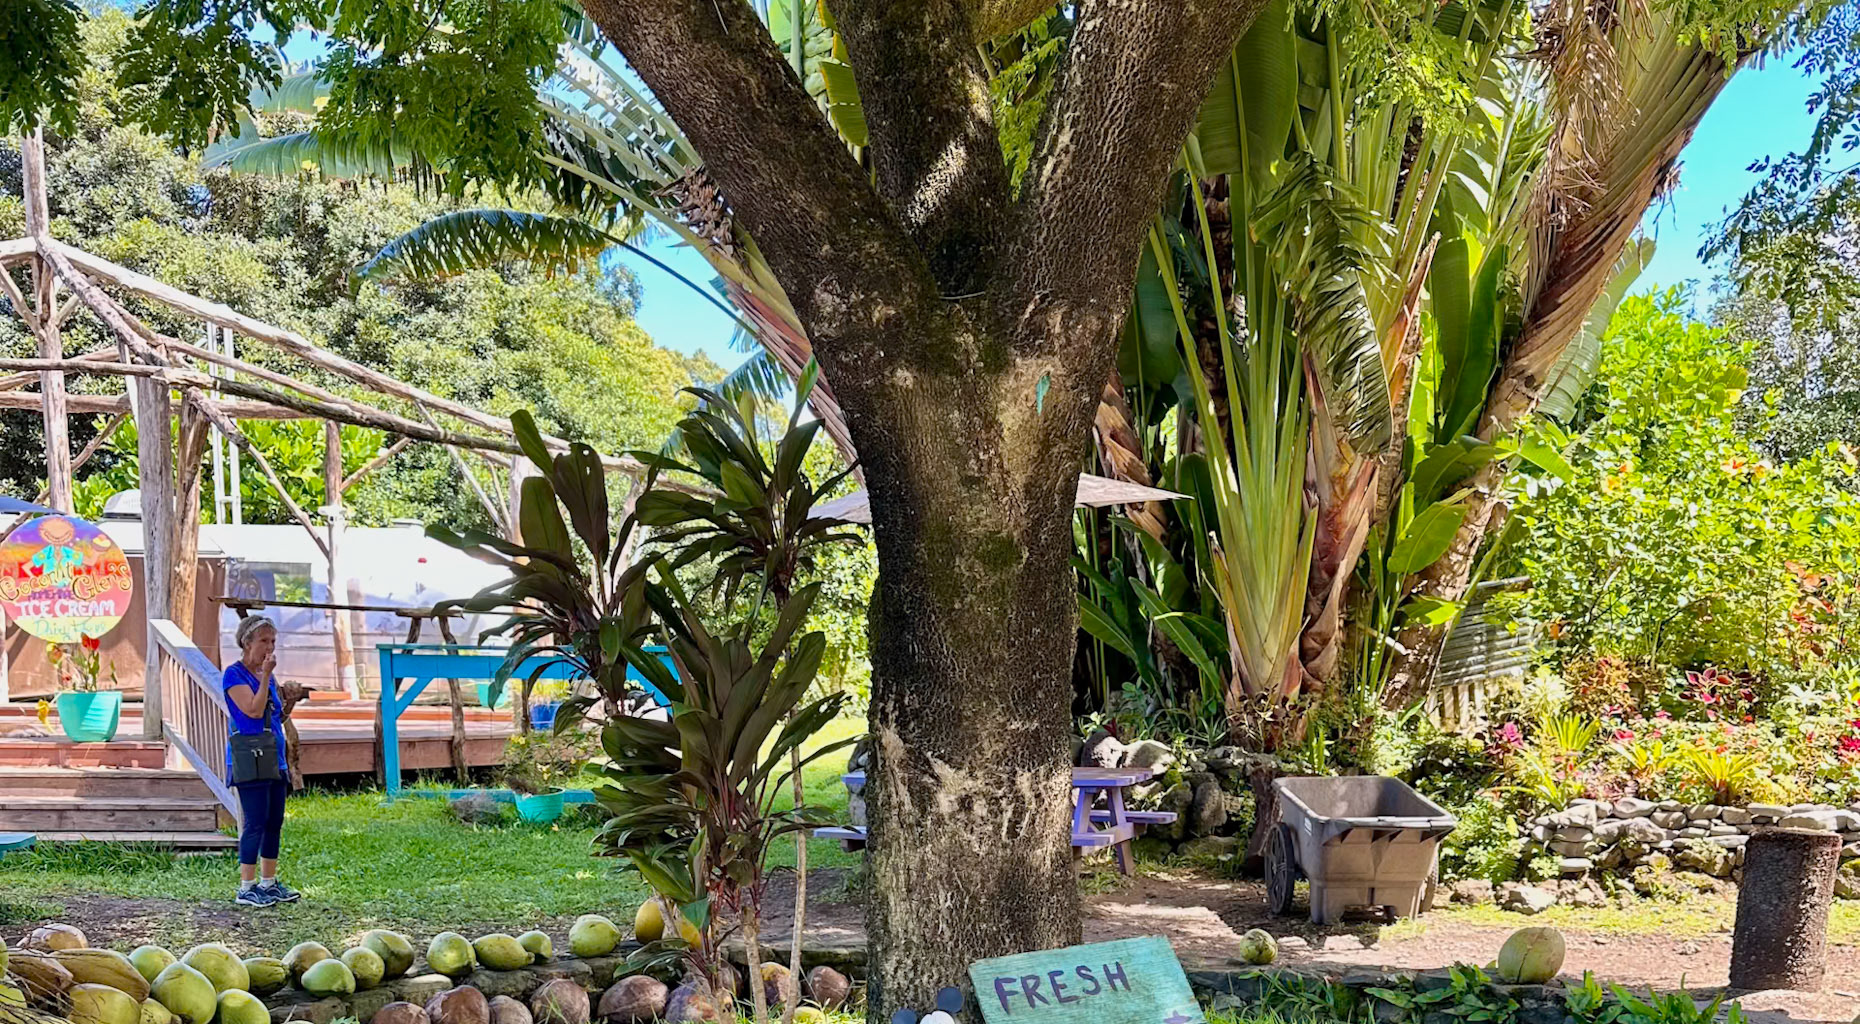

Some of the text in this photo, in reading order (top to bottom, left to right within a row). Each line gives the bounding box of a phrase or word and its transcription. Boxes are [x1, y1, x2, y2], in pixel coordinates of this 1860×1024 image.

[0, 562, 73, 601] Coconut
[15, 600, 116, 619] ICE CREAM
[994, 961, 1131, 1015] FRESH
